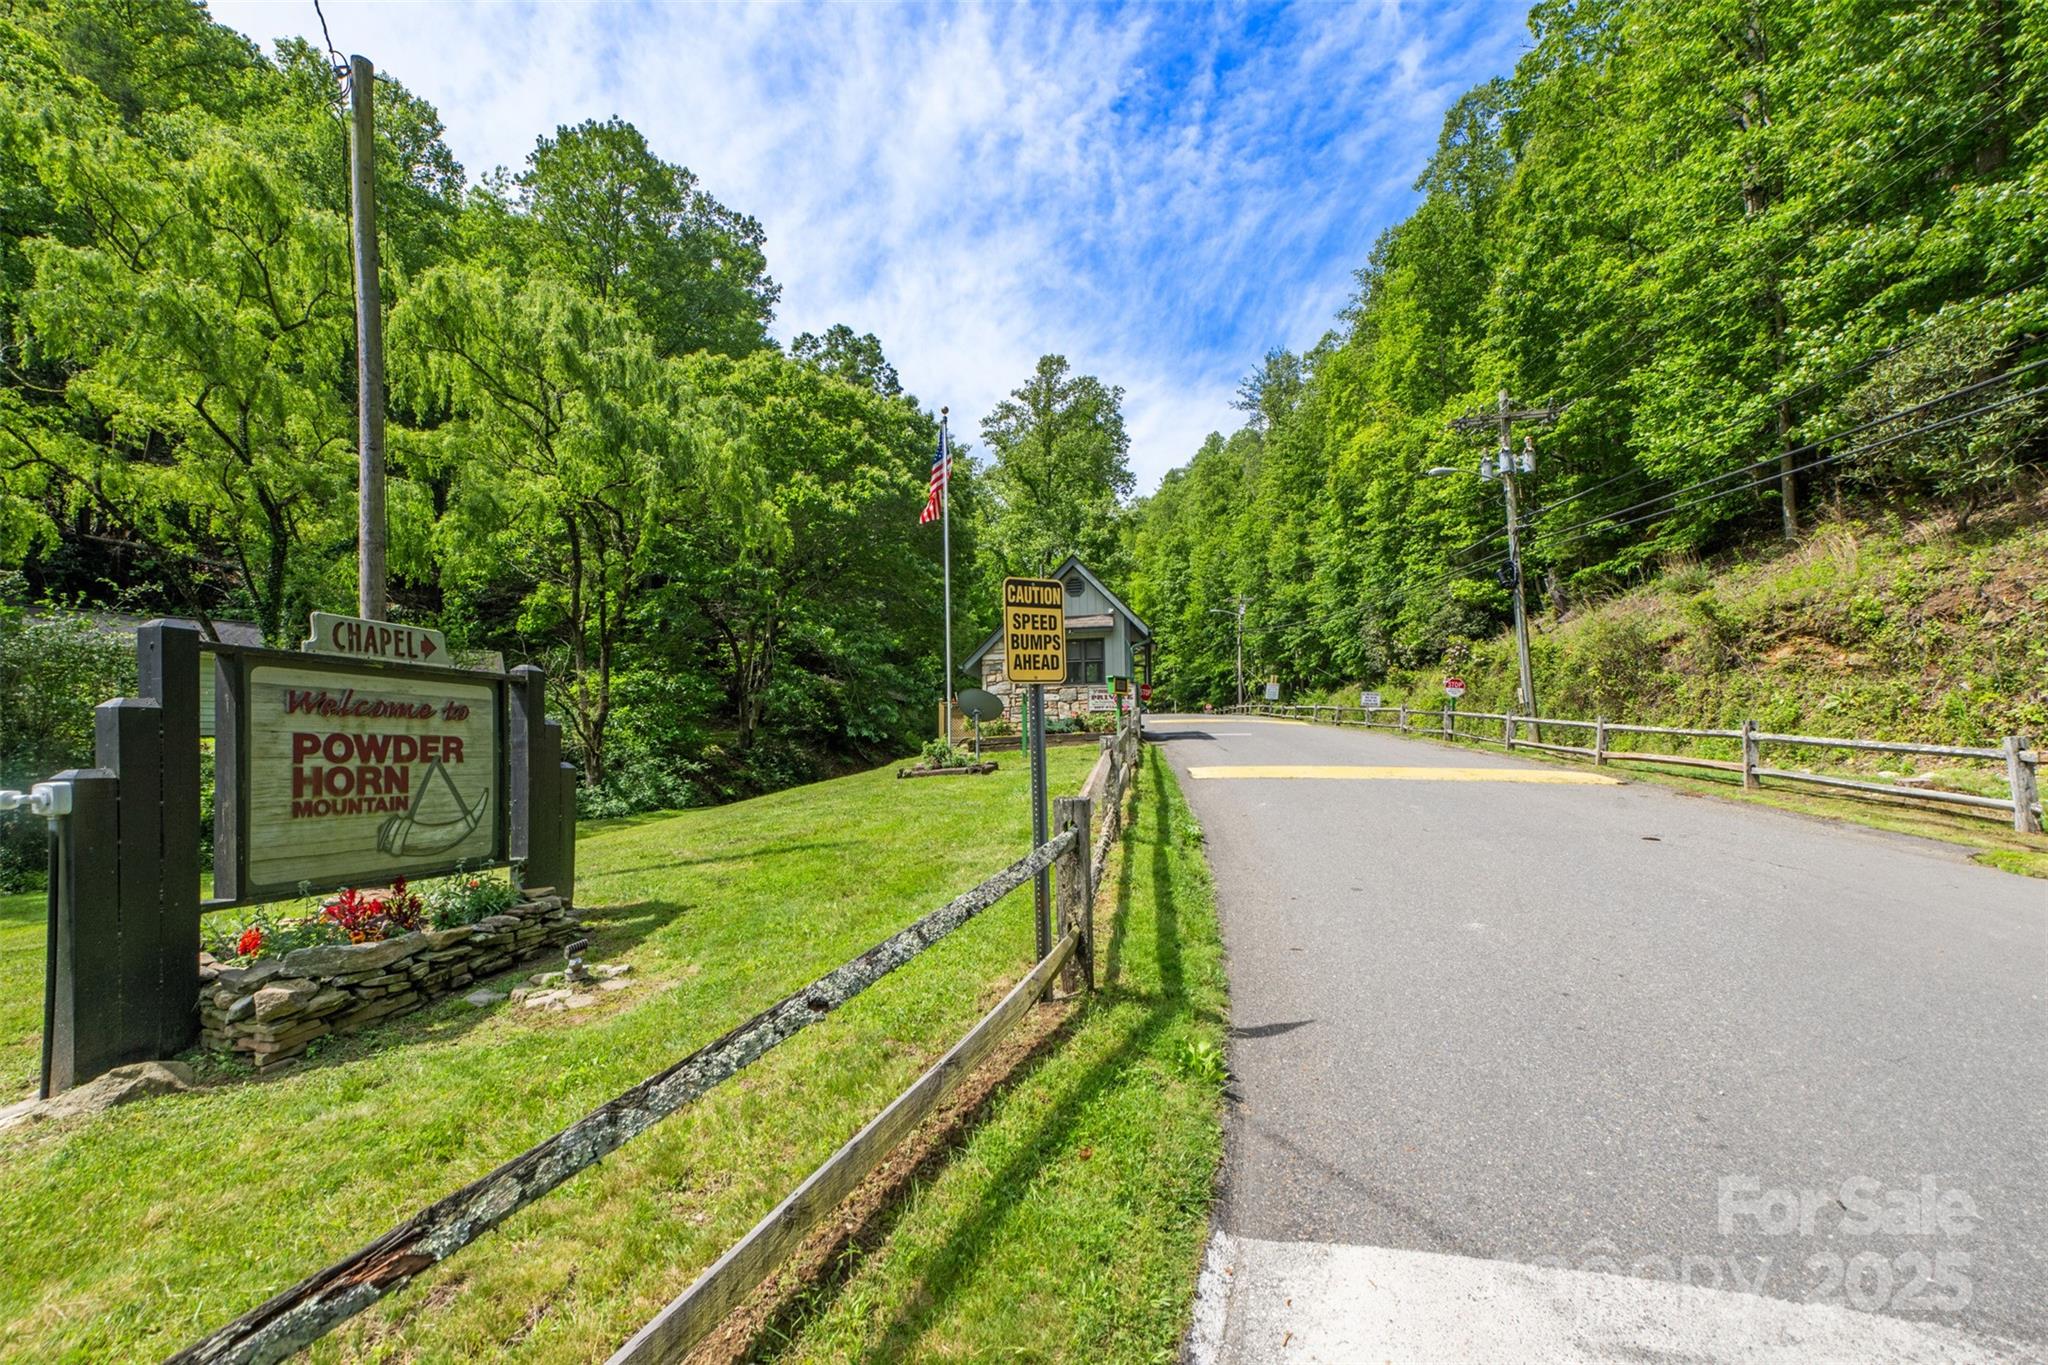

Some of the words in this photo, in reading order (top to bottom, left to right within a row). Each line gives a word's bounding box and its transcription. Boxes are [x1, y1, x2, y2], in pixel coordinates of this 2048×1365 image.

[1007, 584, 1061, 605] CAUTION
[1012, 613, 1058, 631] SPEED
[332, 621, 419, 660] CHAPEL
[1011, 633, 1061, 651] BUMPS
[1013, 654, 1060, 671] AHEAD
[285, 688, 437, 720] Welcome
[441, 700, 470, 721] to
[292, 732, 464, 765] POWDER
[292, 766, 410, 799] HORN
[292, 796, 410, 819] MOUNTAIN
